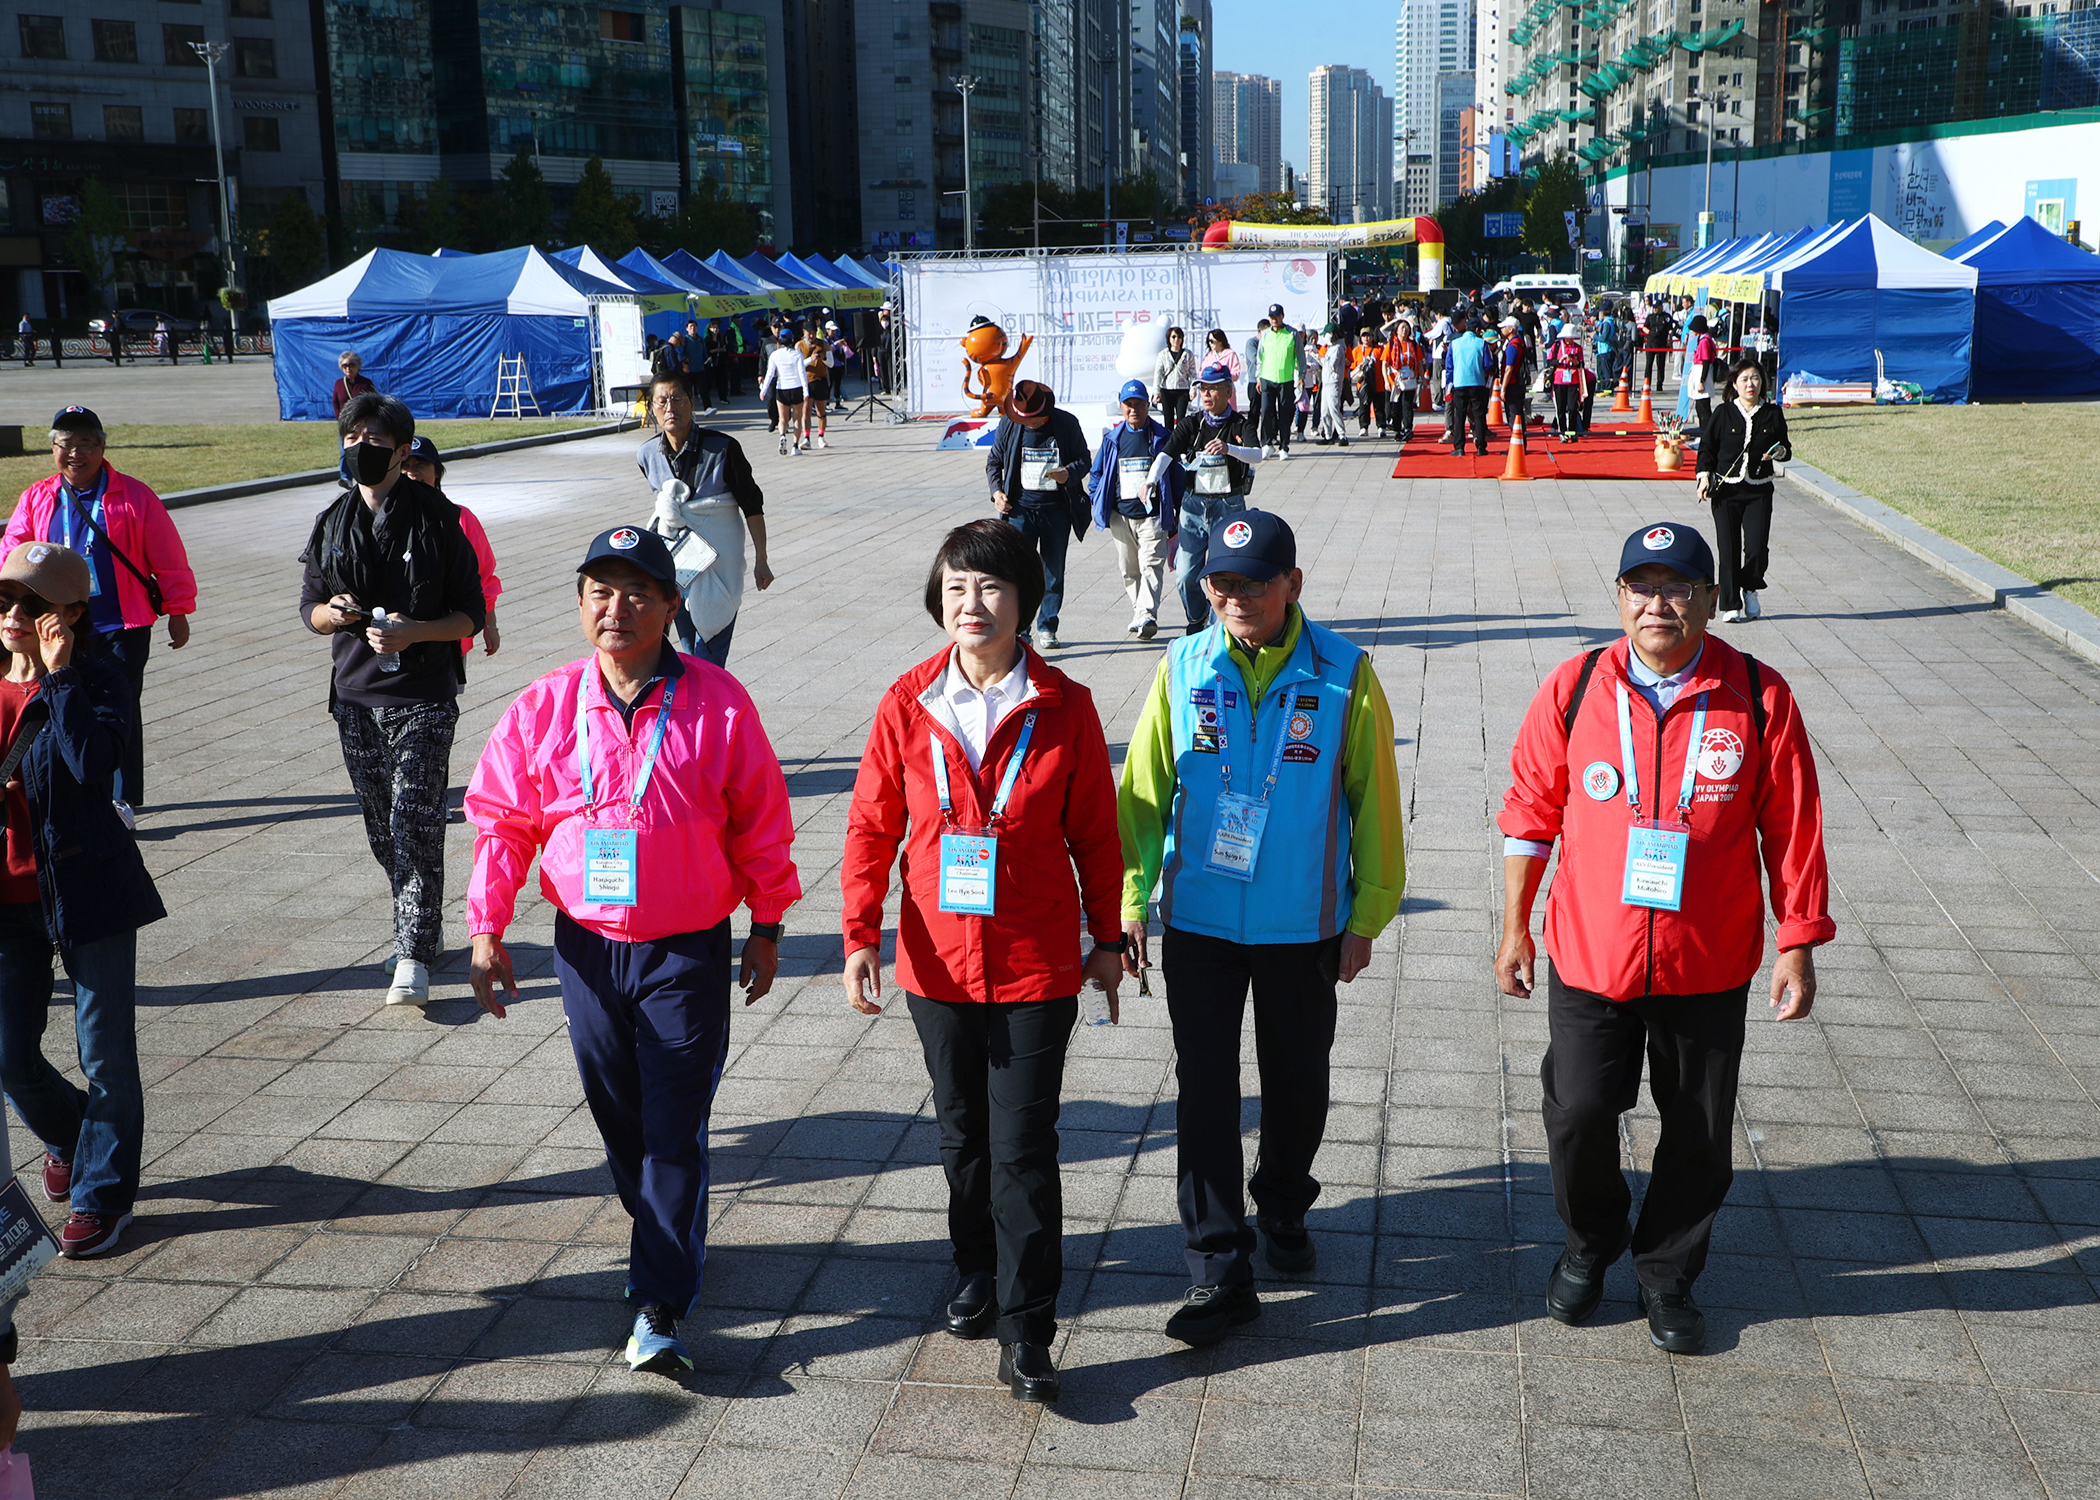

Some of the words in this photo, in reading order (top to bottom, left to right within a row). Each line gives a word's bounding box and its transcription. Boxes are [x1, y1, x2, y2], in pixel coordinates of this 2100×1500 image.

[696, 133, 716, 141] DONNA
[717, 134, 738, 143] STUDIO
[1373, 230, 1407, 242] START
[1706, 783, 1739, 792] OLYMPIAD
[1695, 793, 1719, 803] JAPAN
[1719, 792, 1734, 802] 2009
[1647, 842, 1679, 850] ASIANPIAD
[1647, 862, 1674, 871] President
[593, 876, 624, 884] Haraguchi
